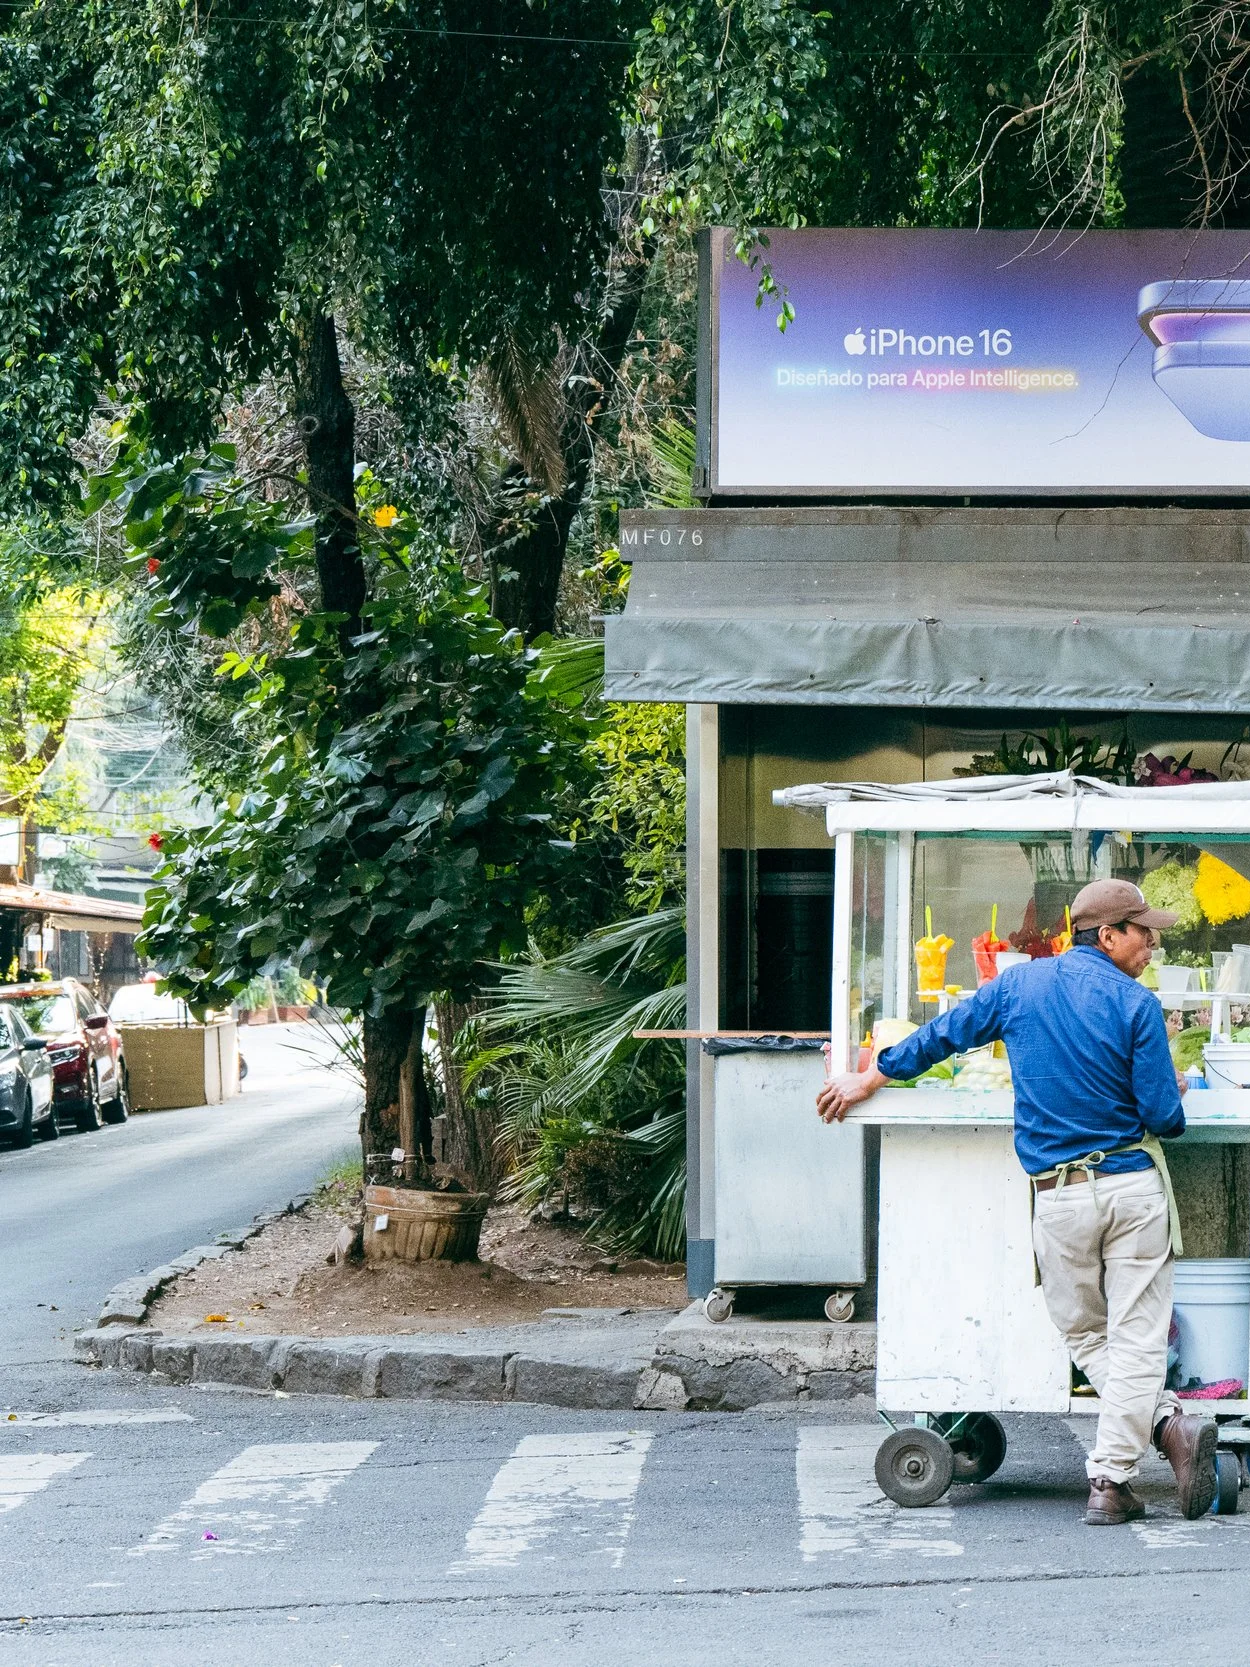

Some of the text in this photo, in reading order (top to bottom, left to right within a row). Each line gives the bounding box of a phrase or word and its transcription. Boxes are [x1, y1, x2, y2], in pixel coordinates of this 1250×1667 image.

[870, 328, 1013, 356] iPhone 16
[777, 368, 1079, 391] Diseñado para Apple Intelligence.
[621, 529, 703, 546] MF076
